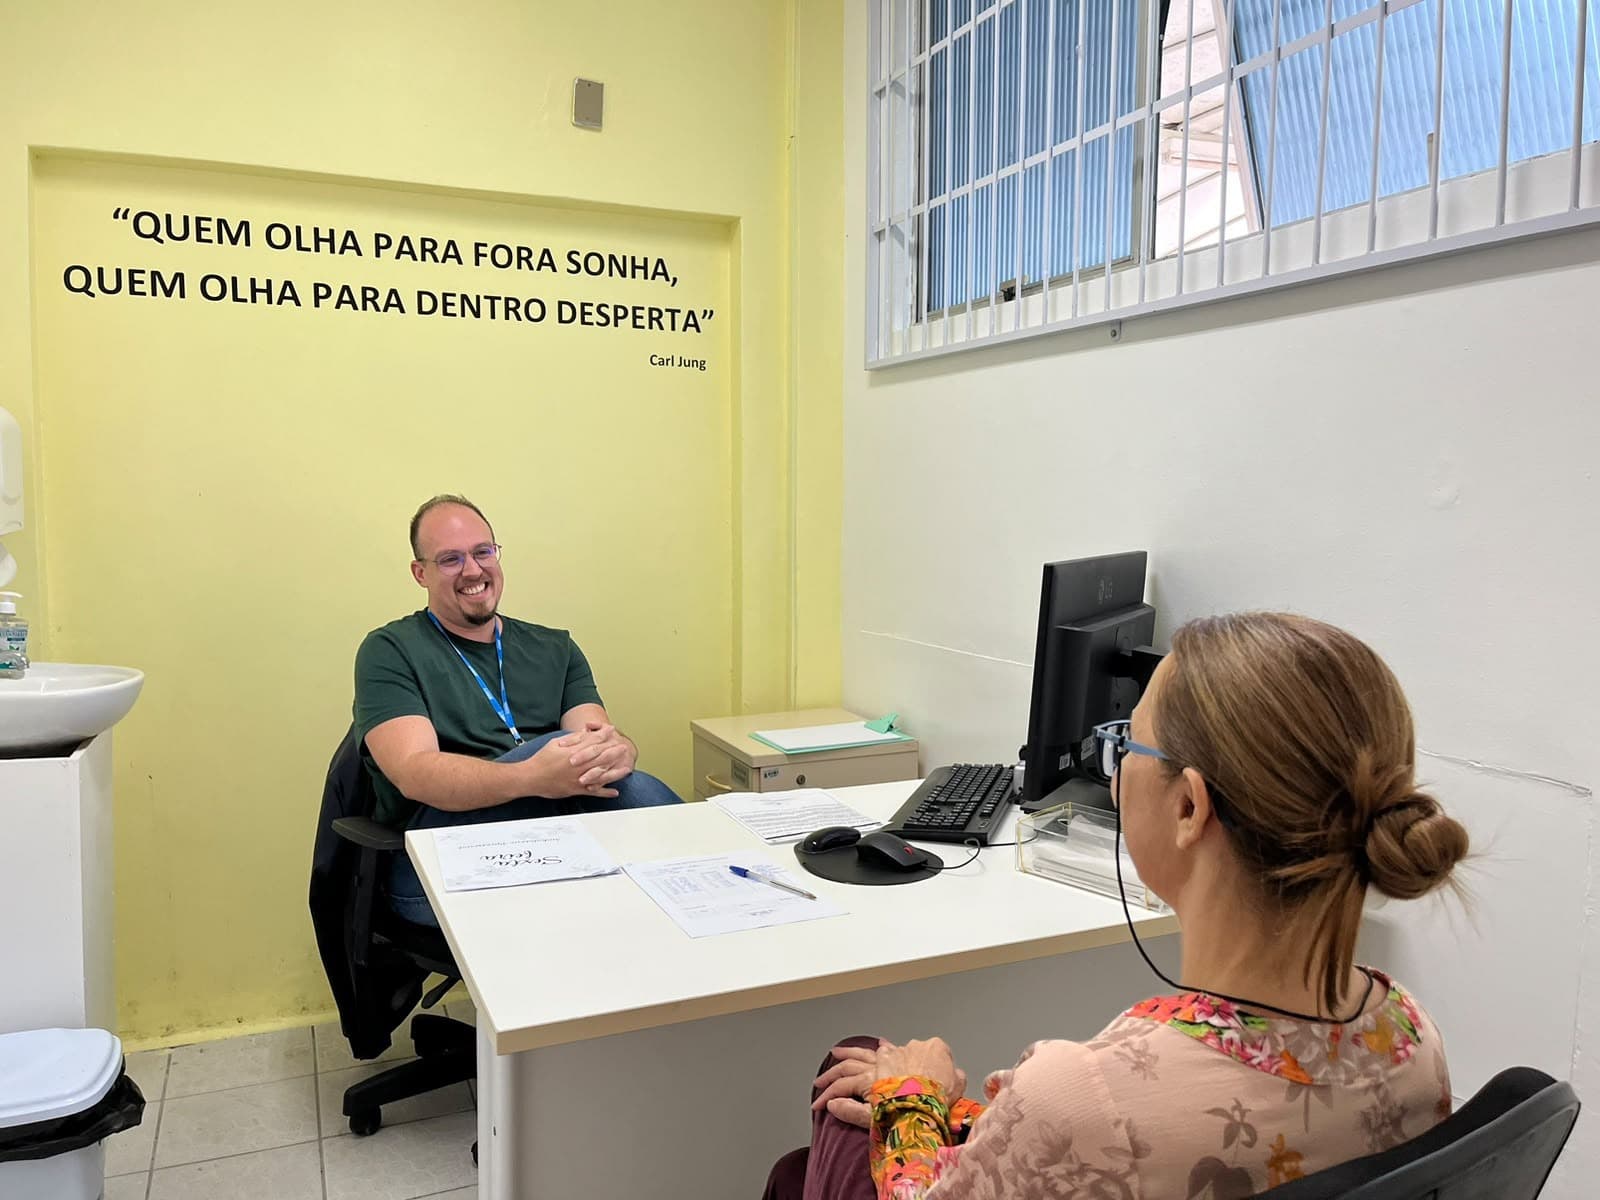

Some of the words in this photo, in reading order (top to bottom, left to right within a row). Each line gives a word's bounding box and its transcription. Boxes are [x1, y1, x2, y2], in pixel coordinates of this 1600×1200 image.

[112, 207, 251, 247] “QUEM
[265, 222, 363, 257] OLHA
[374, 232, 464, 264] PARA
[474, 242, 558, 273] FORA
[566, 250, 678, 287] SONHA,
[63, 265, 186, 299] QUEM
[199, 274, 303, 308] OLHA
[313, 282, 406, 314] PARA
[416, 290, 547, 323] DENTRO
[557, 300, 714, 334] DESPERTA”
[649, 354, 675, 368] Carl
[677, 356, 707, 373] Jung
